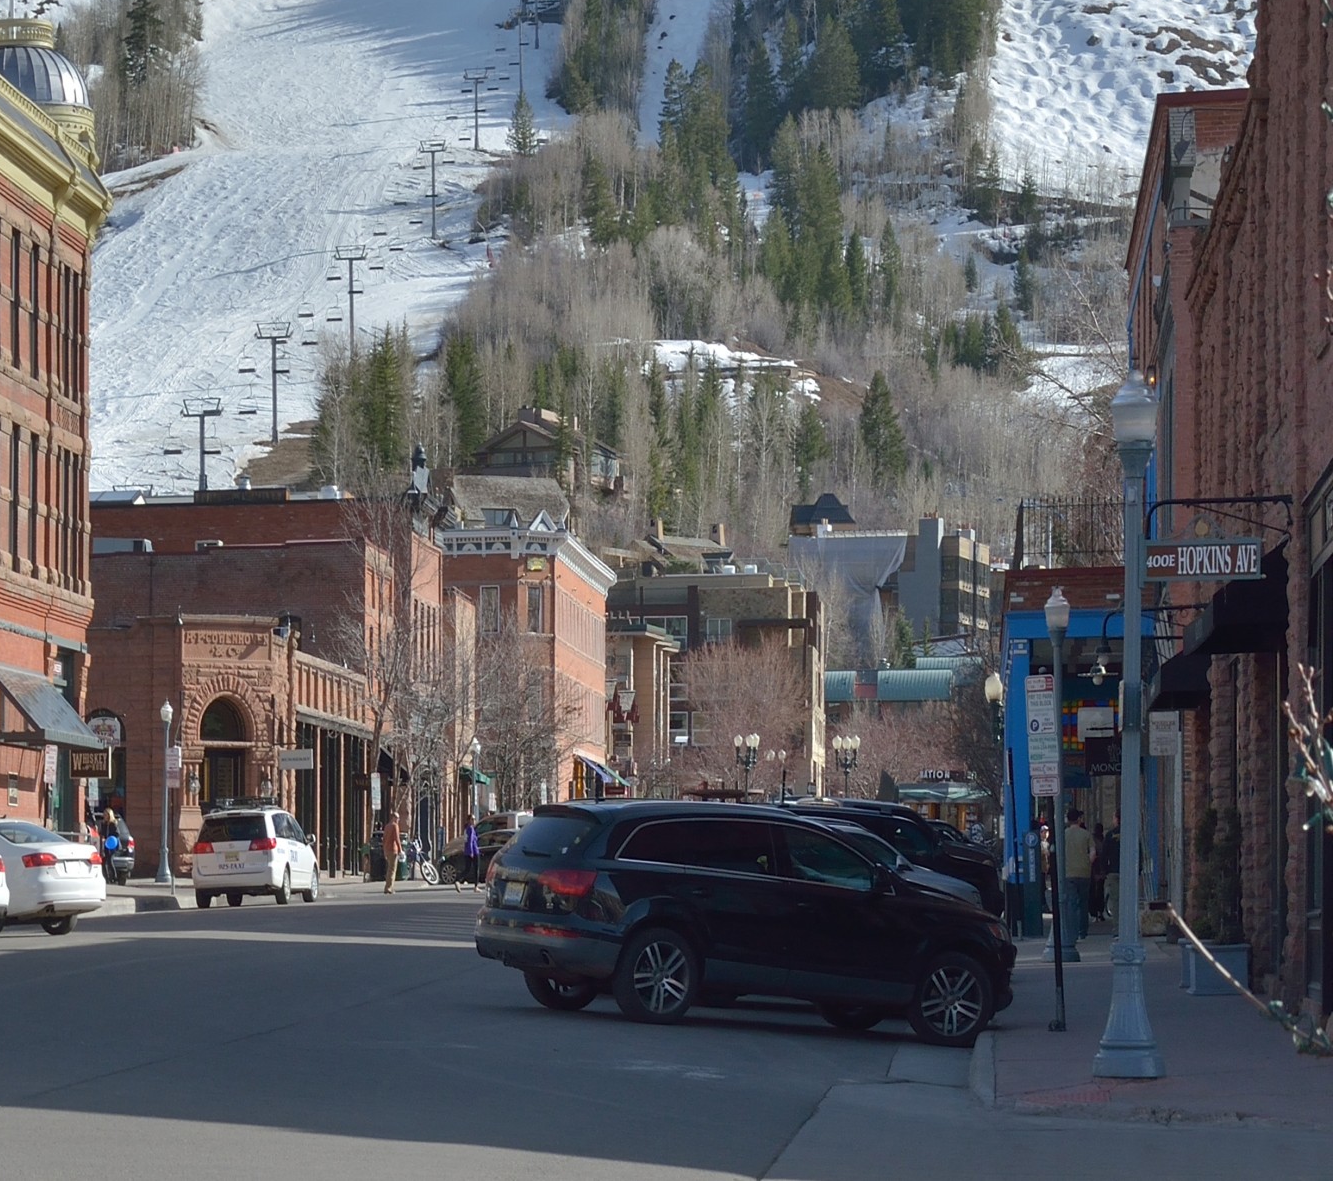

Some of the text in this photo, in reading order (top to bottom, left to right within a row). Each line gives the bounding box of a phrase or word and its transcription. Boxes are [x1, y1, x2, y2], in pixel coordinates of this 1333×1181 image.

[1146, 544, 1257, 575] 400E HOPKINS AVE
[1091, 763, 1121, 772] MONC
